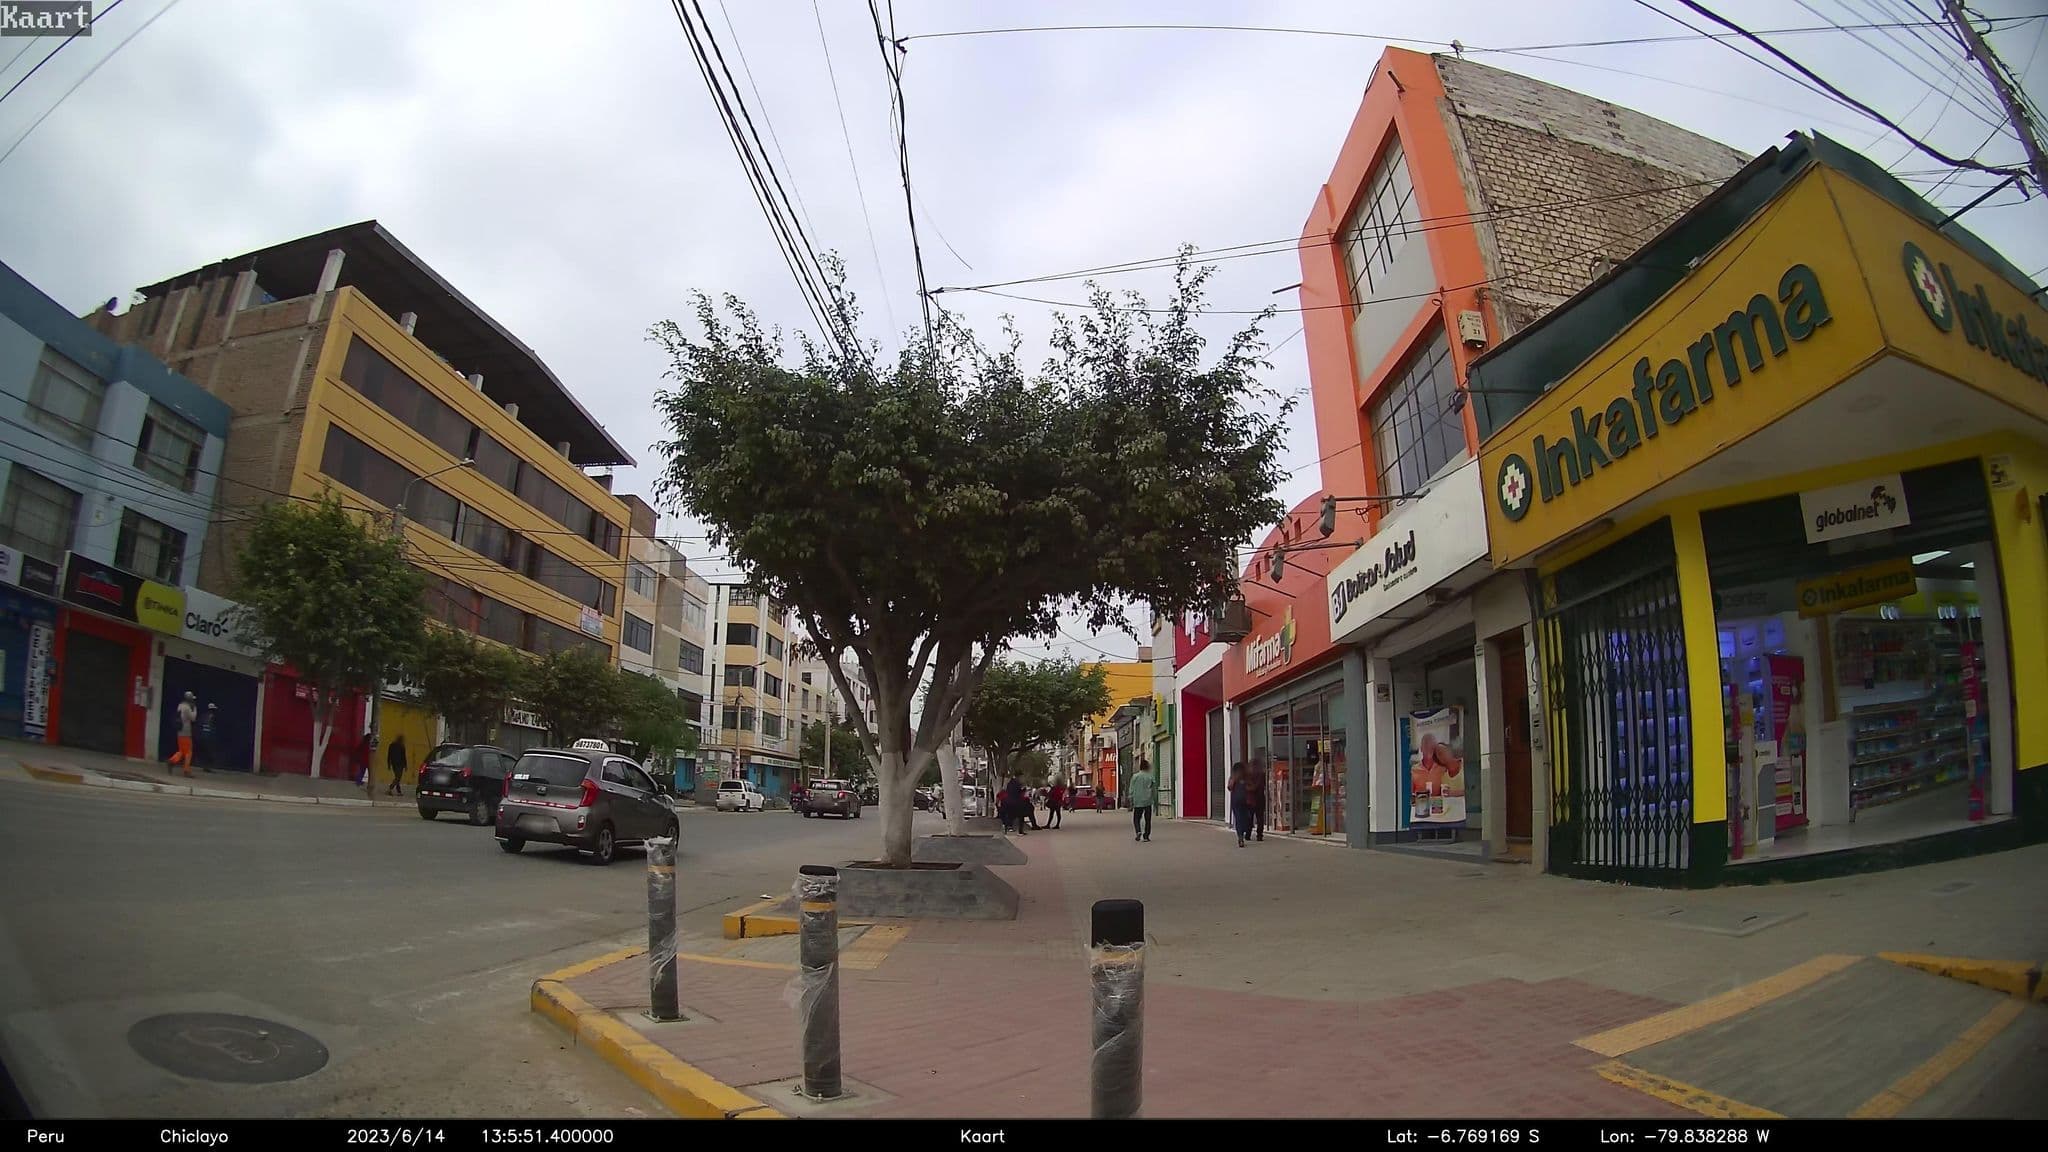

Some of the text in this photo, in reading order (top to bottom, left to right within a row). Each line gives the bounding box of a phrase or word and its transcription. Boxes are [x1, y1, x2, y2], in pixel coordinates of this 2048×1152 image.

[1533, 263, 1832, 504] Inkafarma
[1815, 500, 1880, 532] globalnet
[1345, 563, 1379, 603] Boticas
[1384, 529, 1416, 578] Salud
[1819, 570, 1911, 604] Inkafarma
[185, 612, 222, 637] Claro
[1246, 633, 1281, 674] Mifarma
